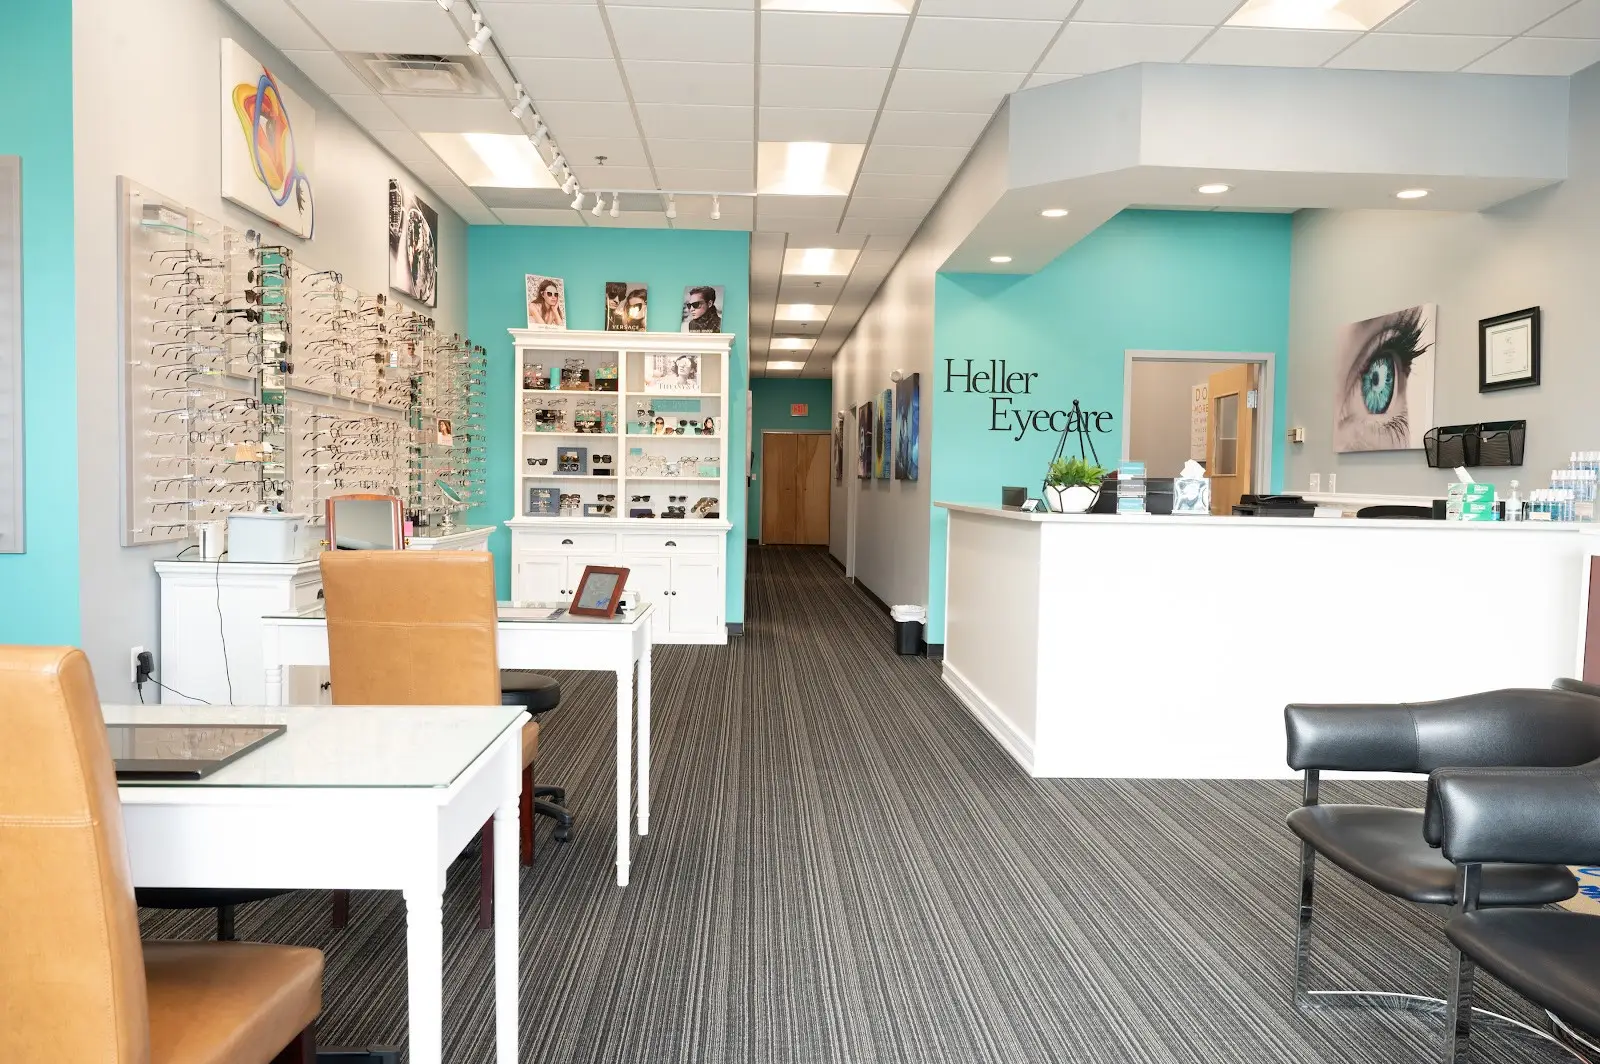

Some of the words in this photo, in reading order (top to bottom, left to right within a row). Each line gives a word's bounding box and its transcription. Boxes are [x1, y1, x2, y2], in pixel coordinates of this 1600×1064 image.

[943, 358, 1039, 395] Heller
[1195, 386, 1208, 402] DO
[988, 396, 1114, 442] Eyecare
